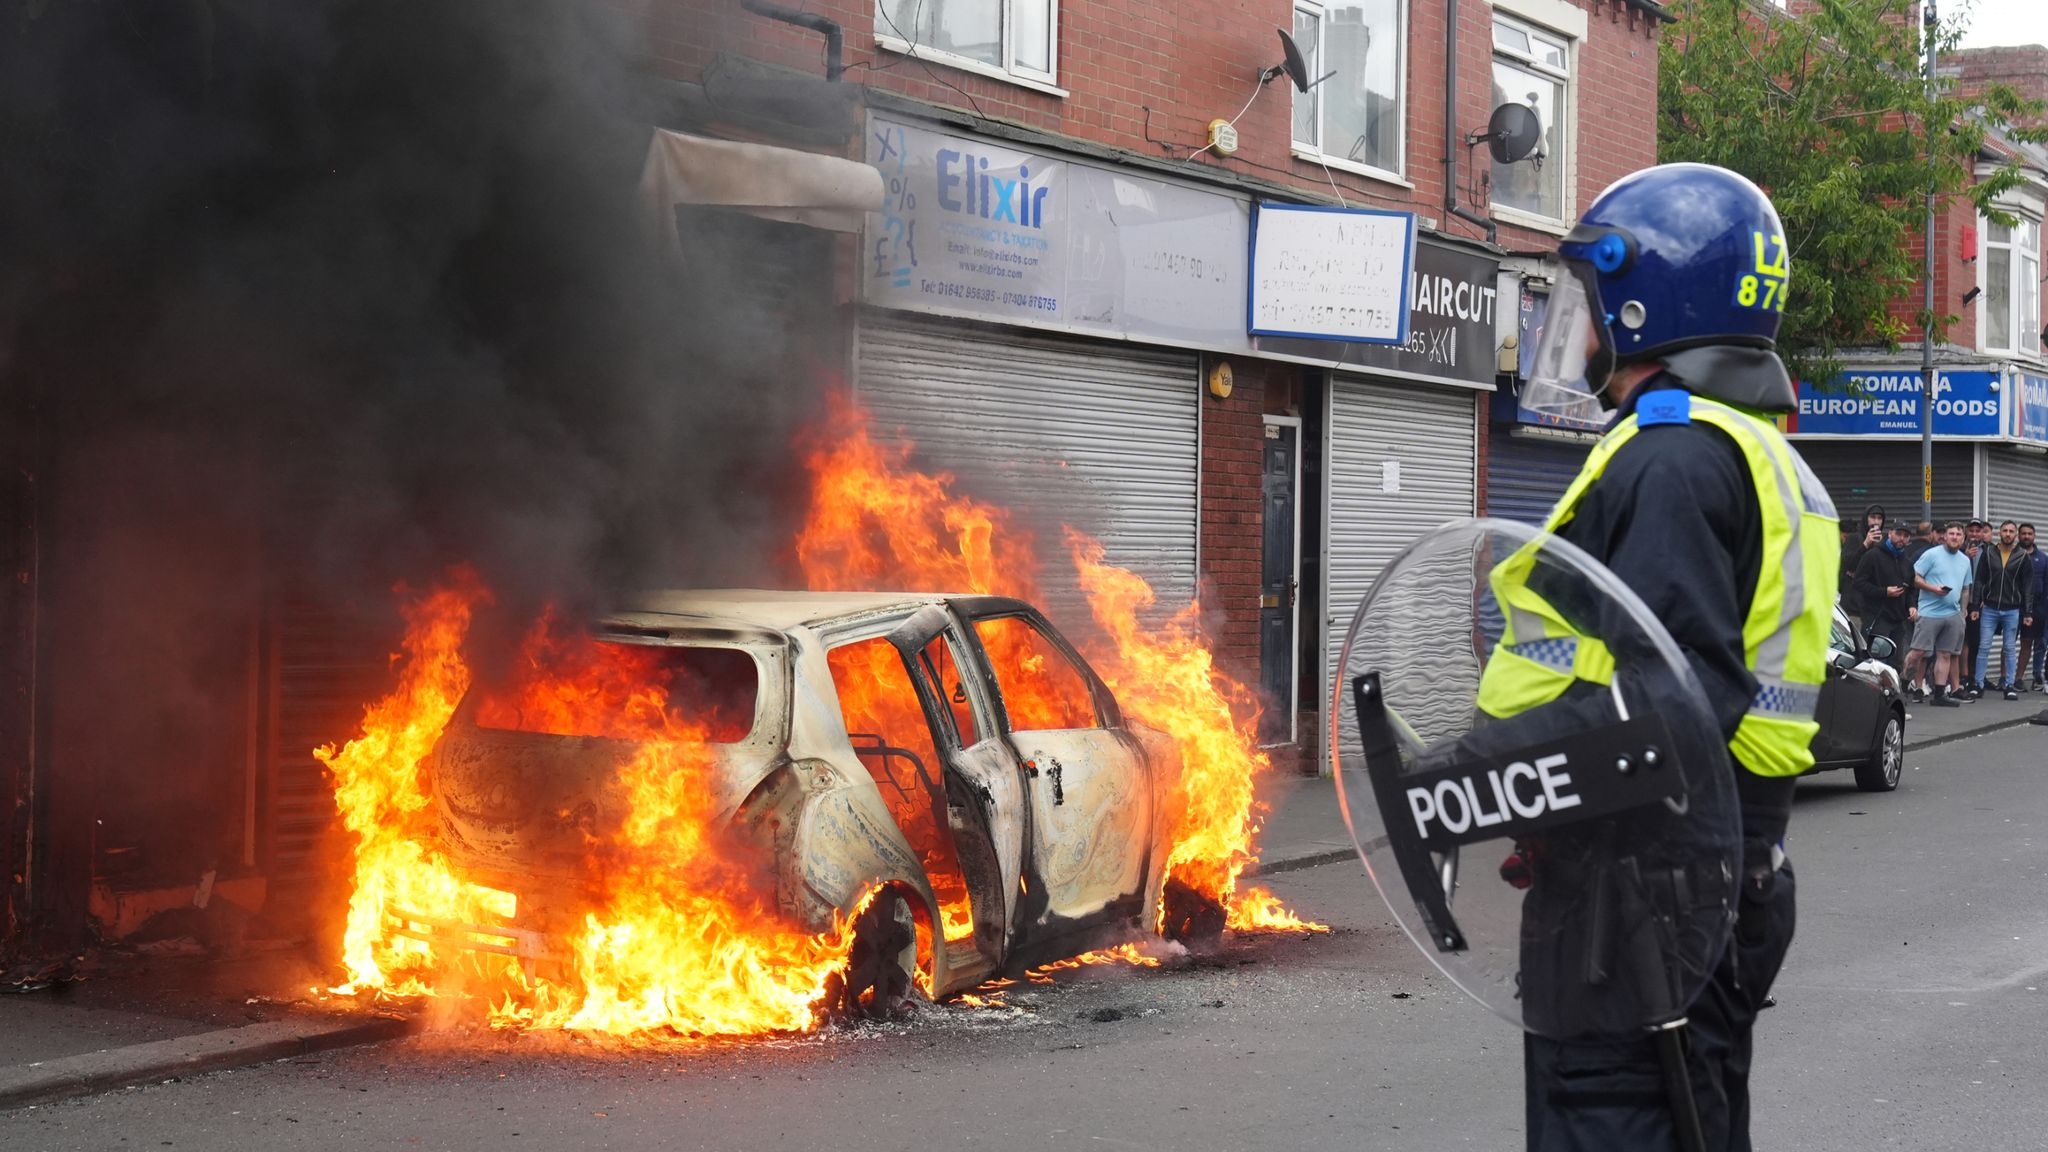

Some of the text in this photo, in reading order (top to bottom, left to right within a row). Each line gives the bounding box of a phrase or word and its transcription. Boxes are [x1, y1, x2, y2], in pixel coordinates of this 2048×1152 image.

[936, 148, 1049, 230] Elixir
[1754, 231, 1786, 278] LZ
[938, 281, 964, 299] 01642
[1799, 399, 1916, 416] EUROPEAN
[1880, 421, 1918, 429] EMANUEL
[1406, 752, 1582, 839] POLICE
